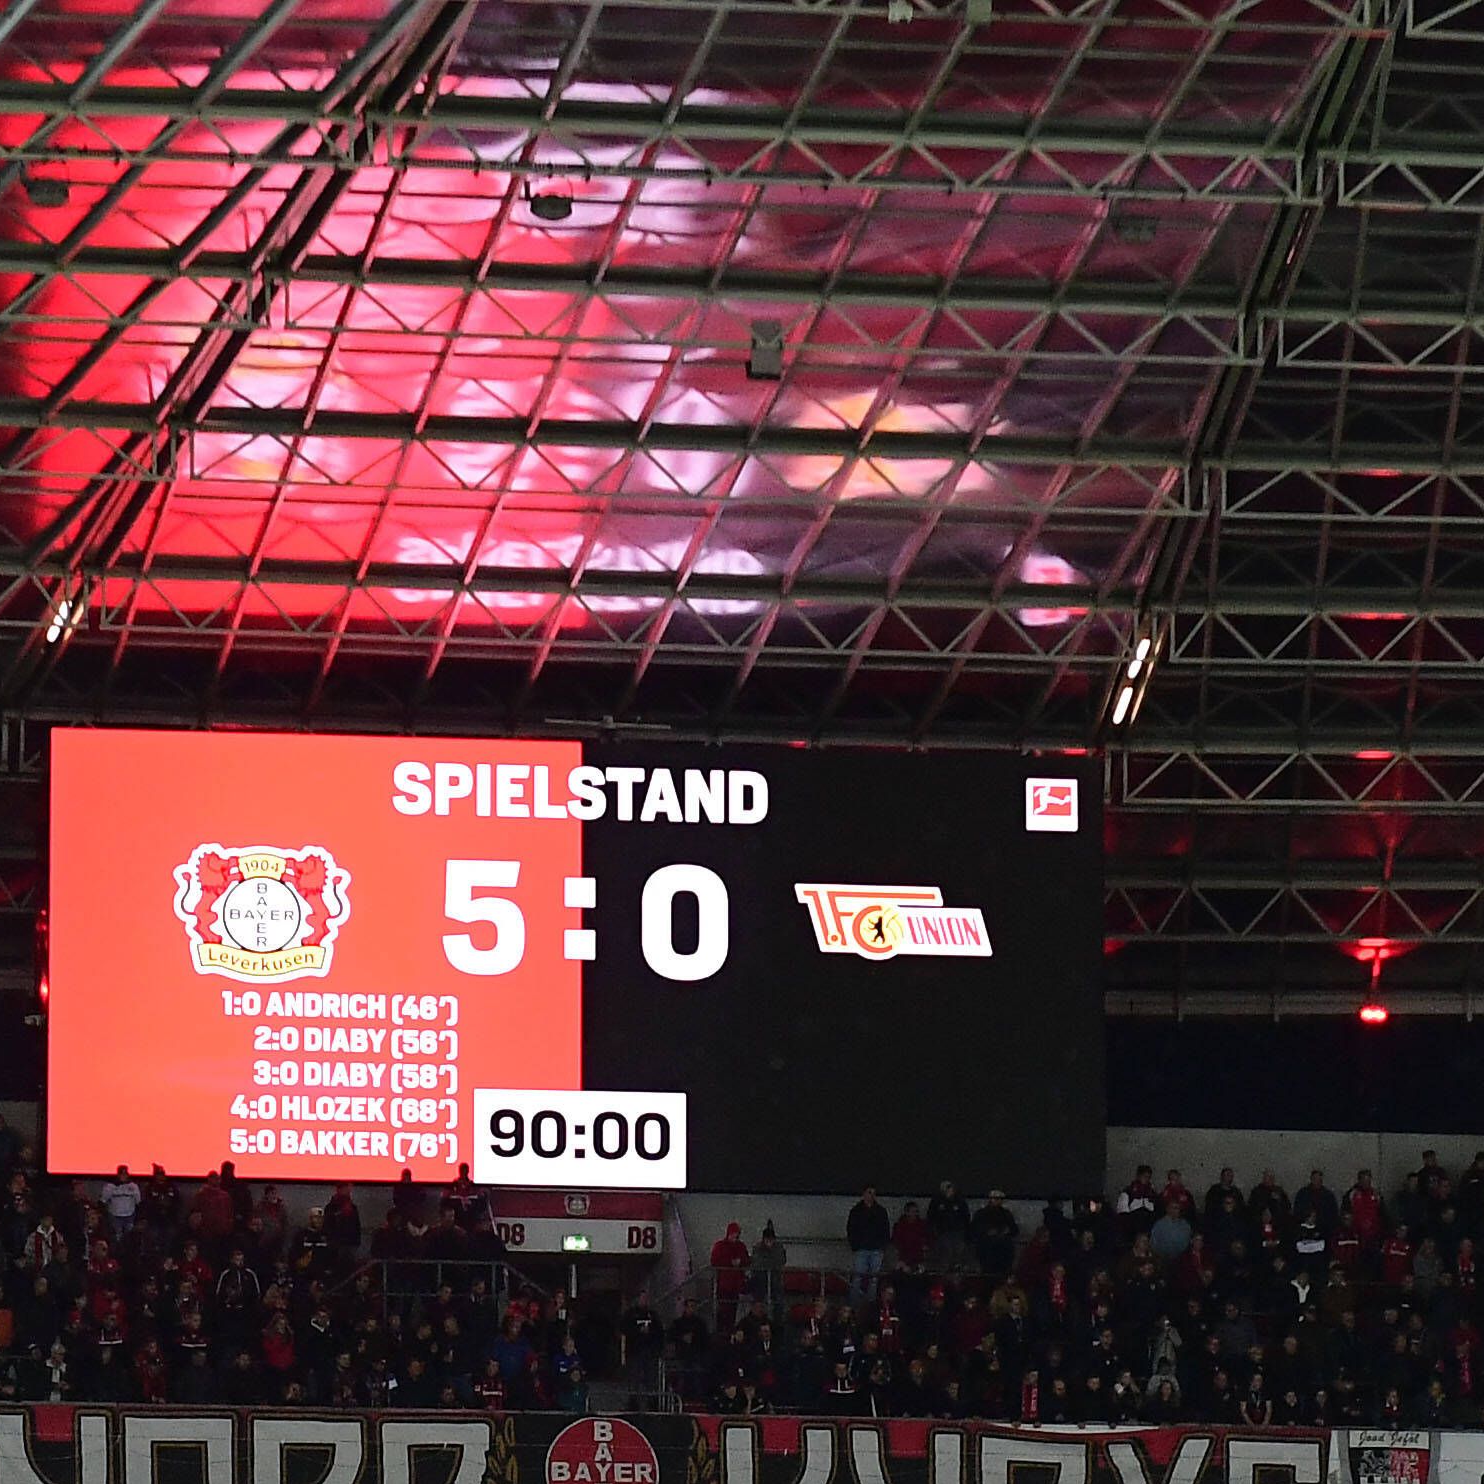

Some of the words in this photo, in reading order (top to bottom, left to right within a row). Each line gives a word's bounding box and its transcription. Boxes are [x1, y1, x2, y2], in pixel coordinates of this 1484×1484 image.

[392, 761, 769, 824] SPIELSTAND
[244, 859, 280, 873] 1904
[229, 908, 295, 921] BAYER
[442, 859, 526, 977] 5
[641, 864, 729, 981] 0
[907, 916, 982, 946] UNION
[207, 947, 316, 971] Leverkusen
[221, 990, 261, 1016] 1:0
[265, 991, 386, 1019] ANDRICH
[253, 1026, 299, 1051] 2:0
[303, 1027, 386, 1053] DIABY
[253, 1060, 299, 1086] 3:0
[303, 1061, 386, 1088] DIABY
[230, 1094, 277, 1120] 4:0
[281, 1095, 386, 1122] HLOZEK
[229, 1128, 276, 1154] 5:0
[280, 1129, 389, 1157] BAKKER
[489, 1108, 671, 1161] 90:00
[627, 1226, 657, 1249] D8
[550, 1461, 654, 1484] BAYER
